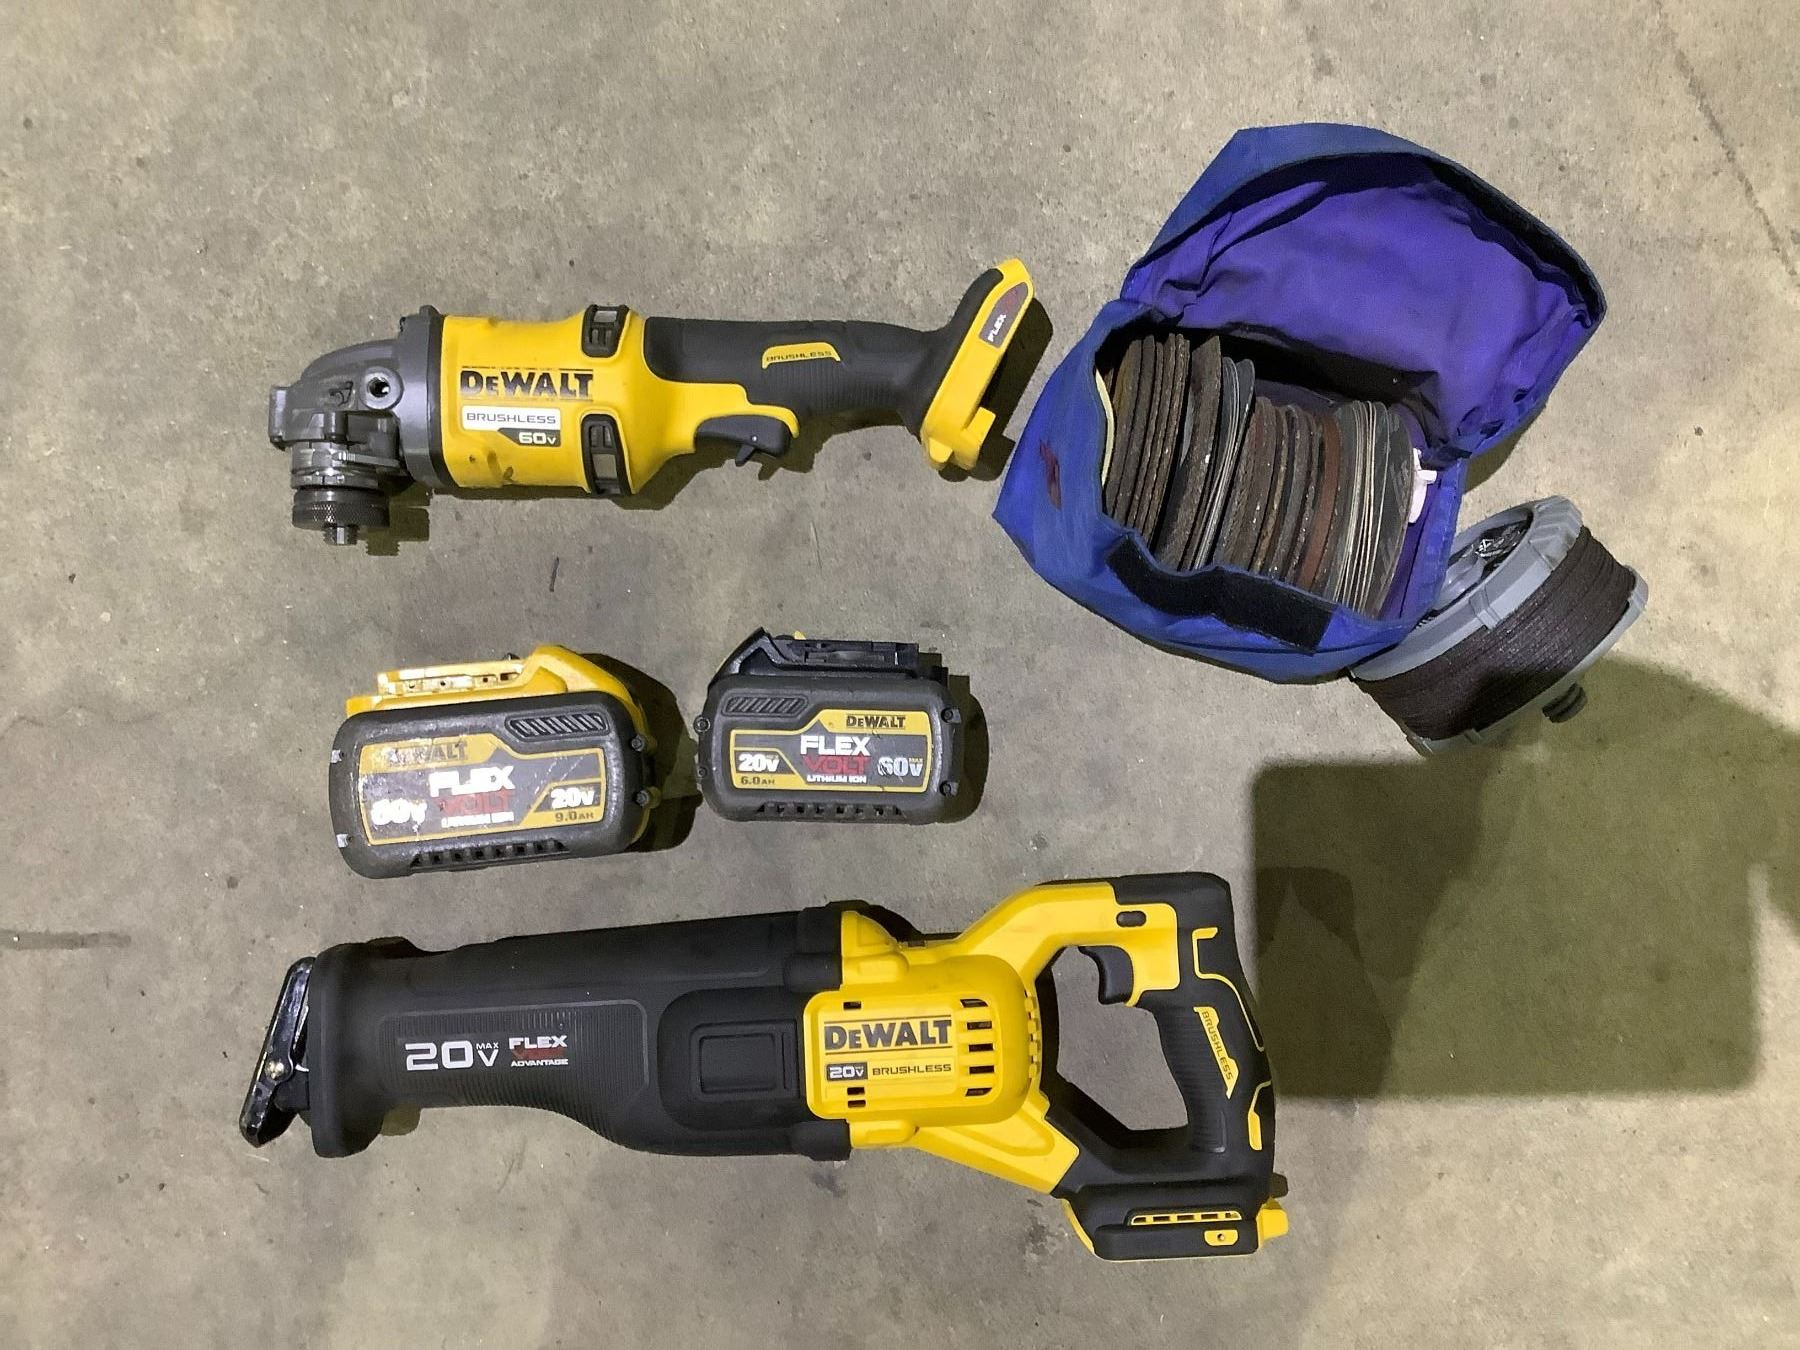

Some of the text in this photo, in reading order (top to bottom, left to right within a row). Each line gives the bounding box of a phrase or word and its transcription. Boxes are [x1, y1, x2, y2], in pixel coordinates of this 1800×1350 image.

[987, 314, 1007, 342] FLEX
[766, 351, 832, 362] BRUSHLESS
[466, 412, 556, 424] BRUSHLESS
[801, 735, 871, 756] FLEX
[803, 755, 871, 775] VOLT
[428, 765, 516, 798] FLEX
[807, 774, 867, 783] LITHIUM ION
[475, 1042, 499, 1050] MAX
[508, 1035, 568, 1050] FLEX
[1200, 1012, 1234, 1081] BRUSHLESS
[405, 1040, 499, 1071] 20V
[511, 1059, 569, 1067] ADVANTAGE
[872, 1064, 952, 1076] BRUSHLESS
